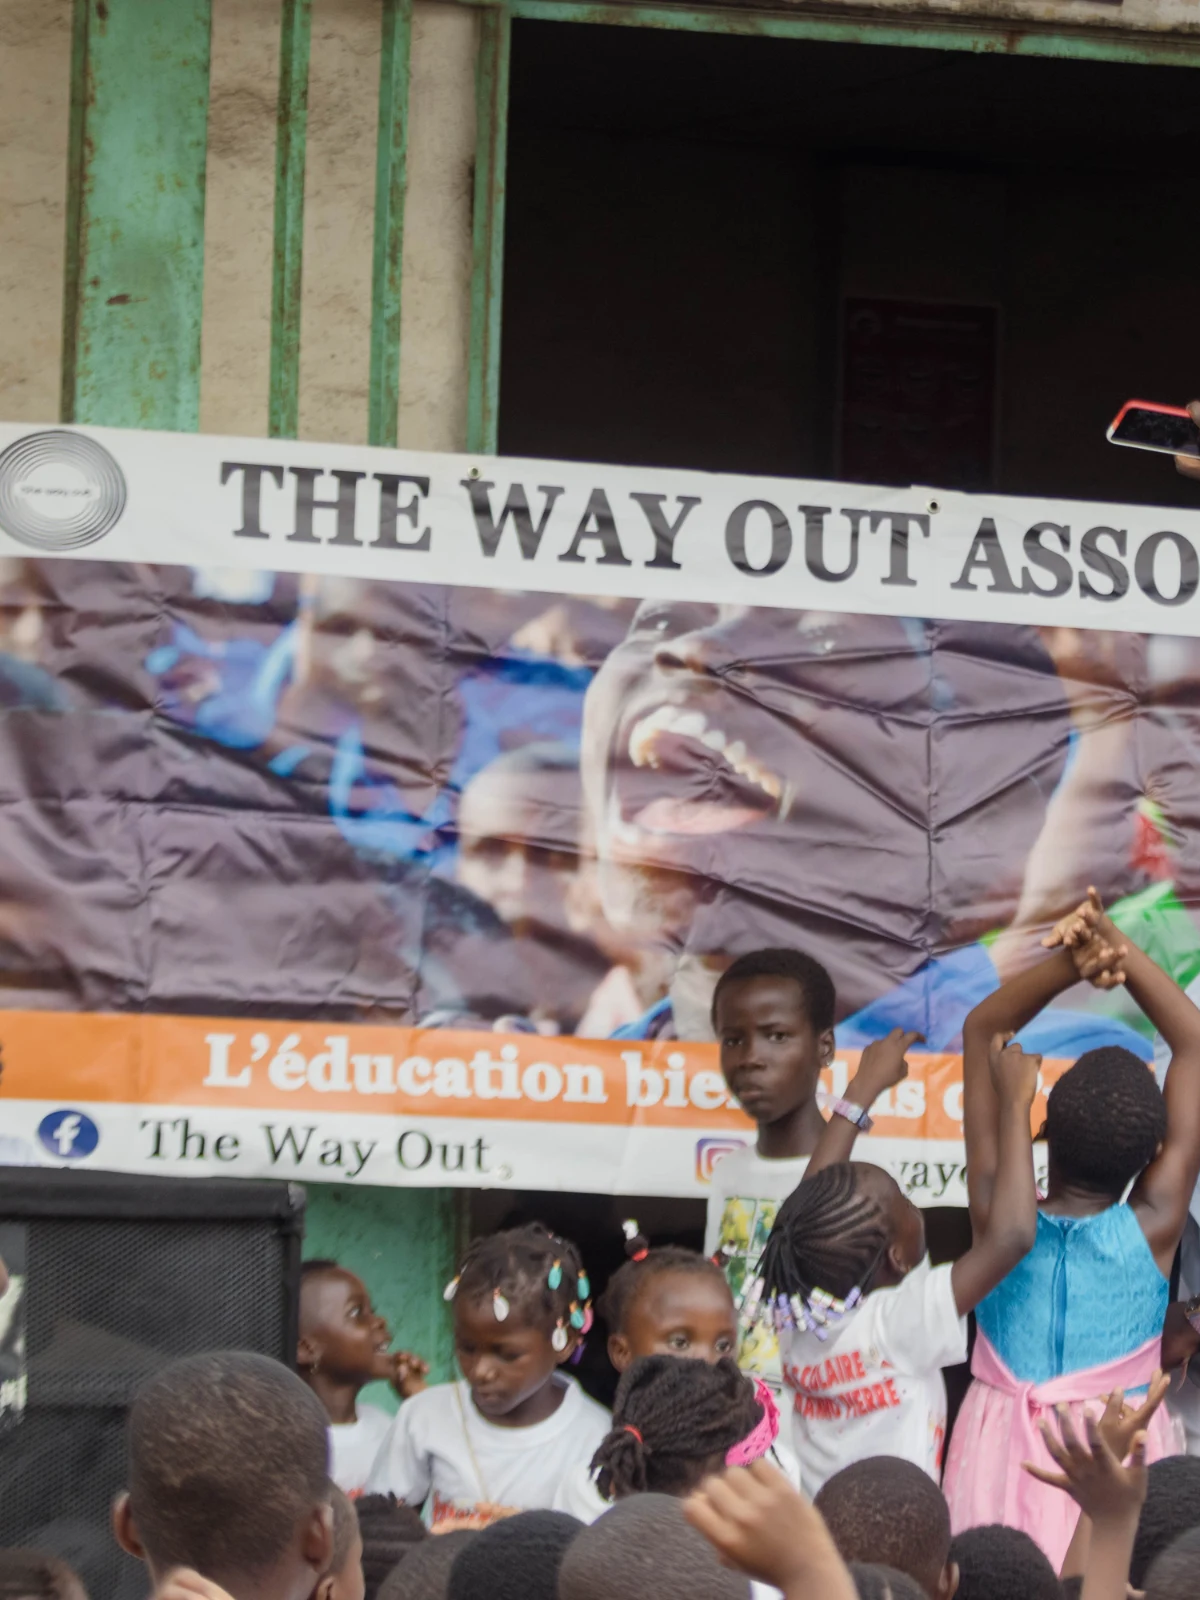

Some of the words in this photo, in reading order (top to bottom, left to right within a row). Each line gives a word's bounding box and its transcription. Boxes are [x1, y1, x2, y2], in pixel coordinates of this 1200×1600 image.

[219, 460, 432, 552] THE
[460, 478, 702, 570] WAY
[724, 499, 930, 587] OUT
[202, 1032, 608, 1104] L'éducation
[620, 1050, 741, 1110] bie
[140, 1117, 241, 1161] The
[259, 1124, 379, 1178] Way
[397, 1130, 491, 1174] Out
